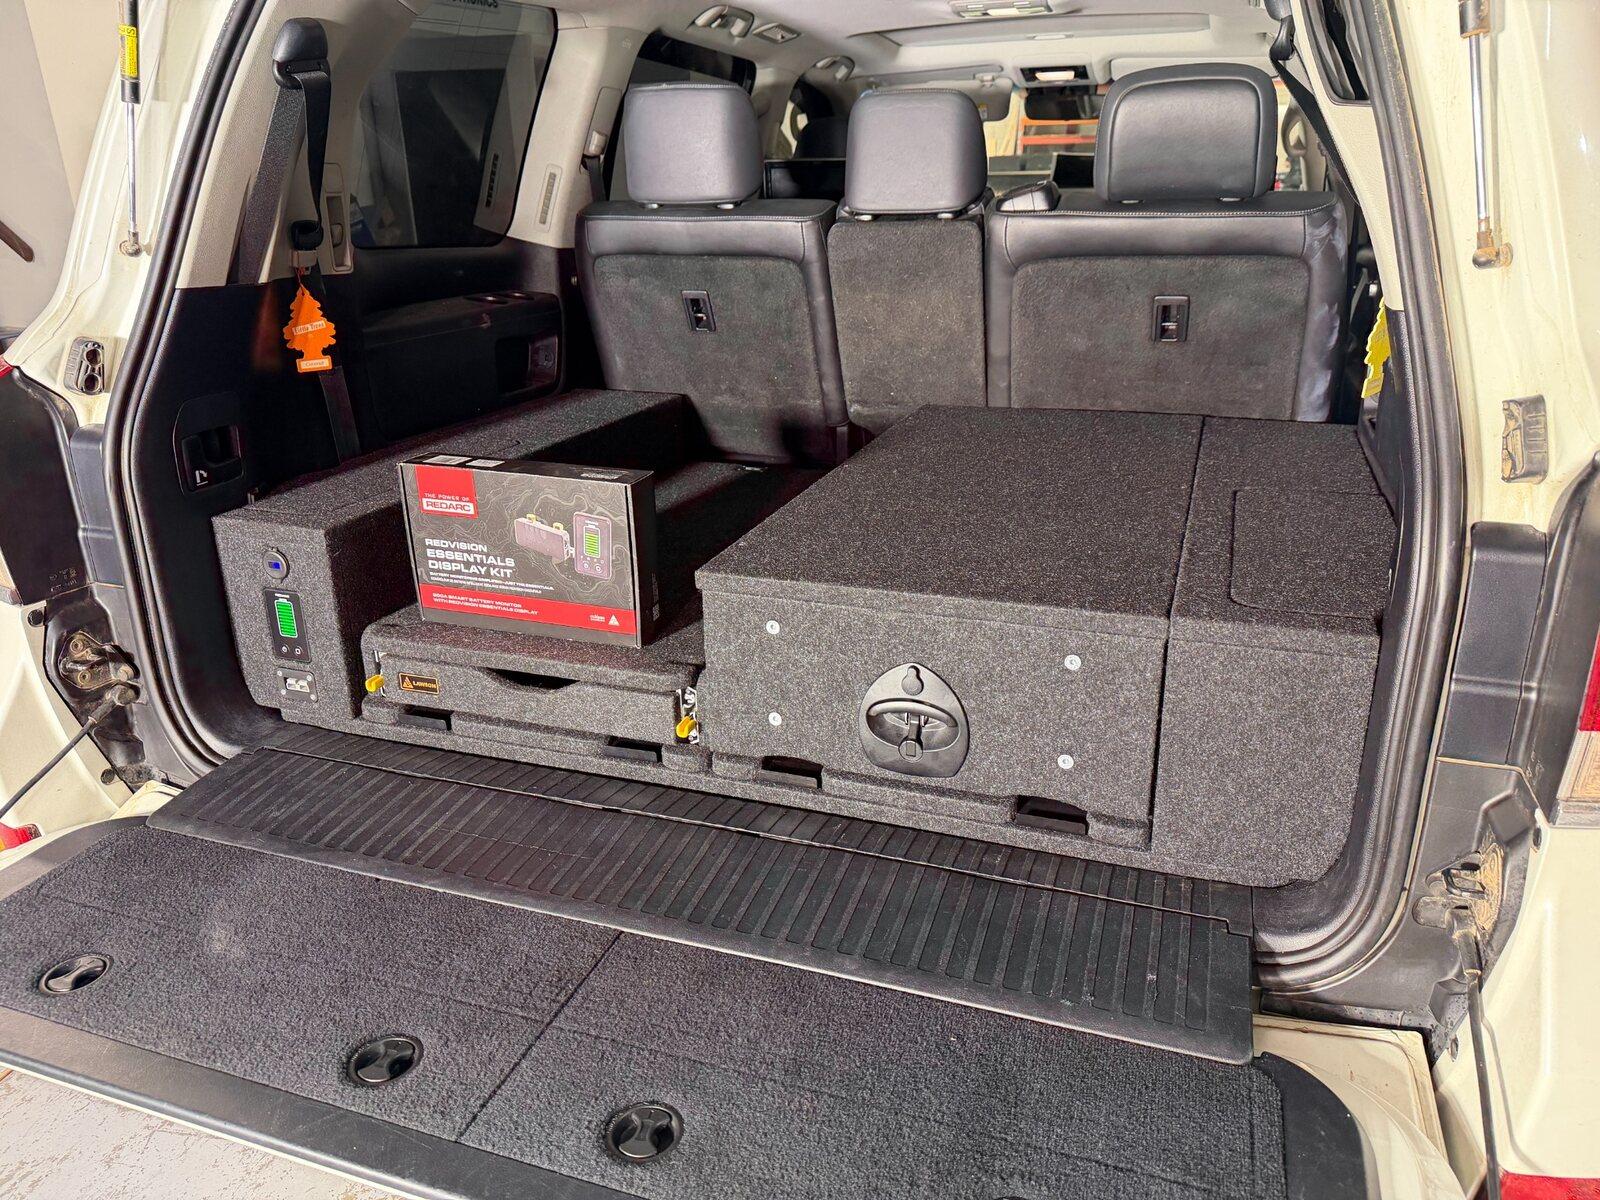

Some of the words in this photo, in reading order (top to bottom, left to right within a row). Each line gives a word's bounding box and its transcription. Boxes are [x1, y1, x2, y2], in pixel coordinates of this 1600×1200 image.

[426, 500, 471, 511] REDARC
[425, 538, 487, 552] REDVISION
[426, 548, 515, 567] ESSENTIALS
[428, 559, 486, 575] DISPLAY
[490, 567, 513, 578] KIT
[448, 599, 478, 607] REDVISION
[479, 603, 513, 612] ESSENTIALS
